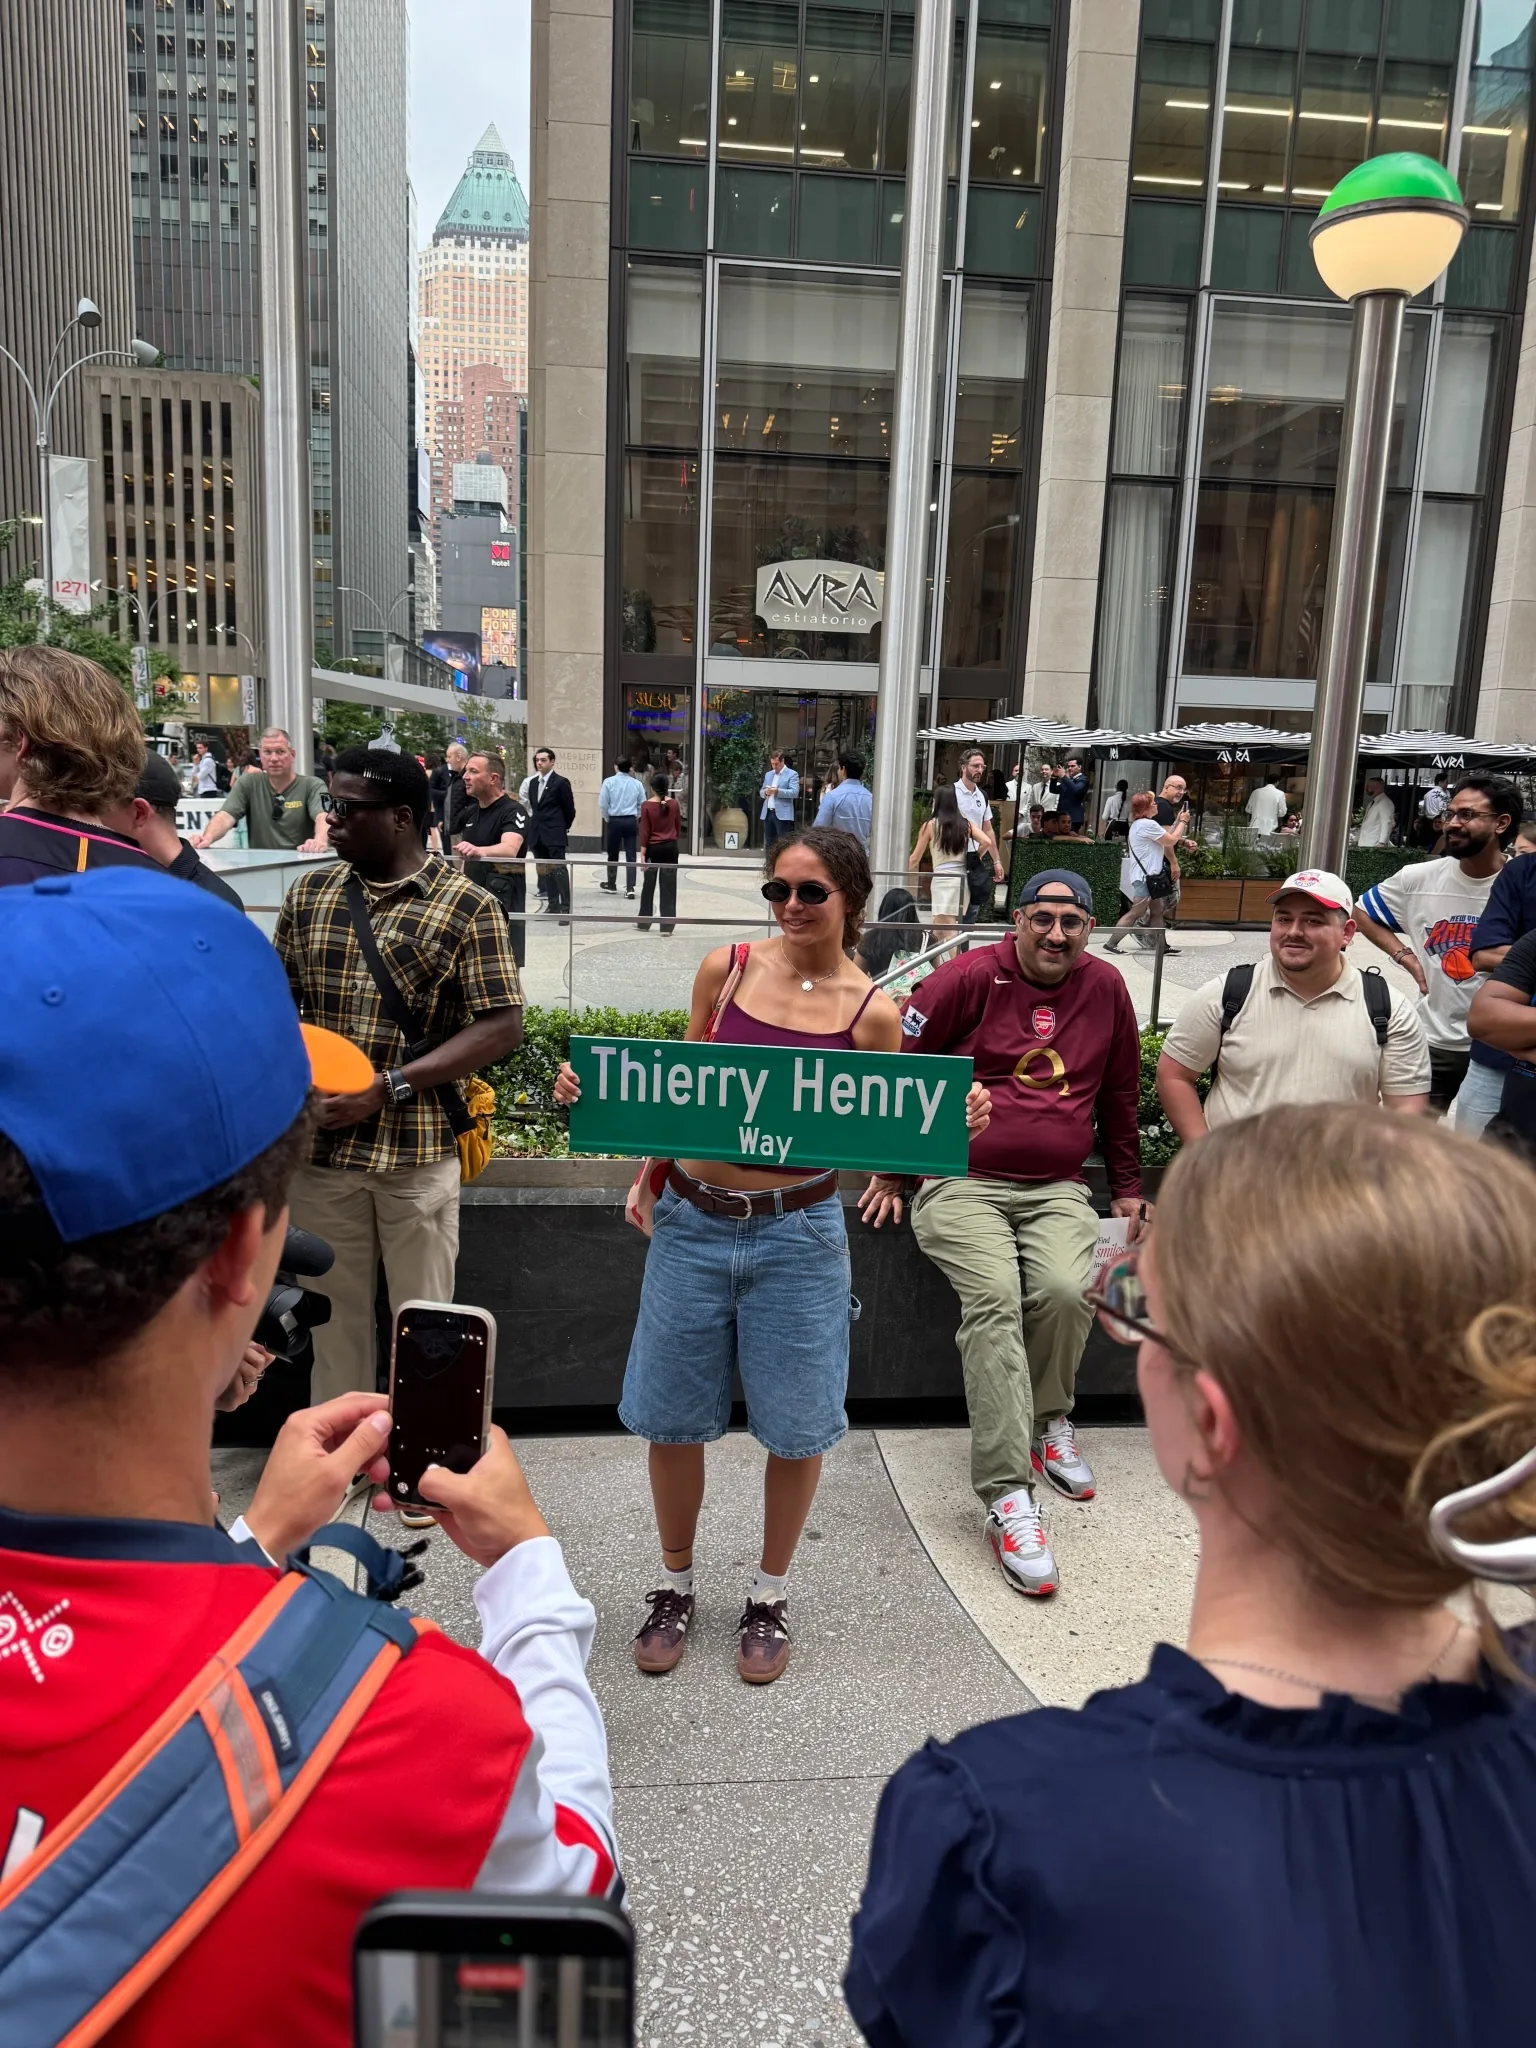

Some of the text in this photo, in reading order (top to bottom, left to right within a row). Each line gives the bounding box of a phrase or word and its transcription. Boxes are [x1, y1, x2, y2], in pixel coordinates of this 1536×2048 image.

[56, 580, 88, 596] 1271
[763, 568, 878, 613] AVRA
[771, 612, 868, 627] estiatorio
[556, 762, 597, 771] UILDING
[1432, 753, 1465, 769] AVRA
[727, 834, 737, 845] A
[1450, 914, 1467, 923] NEW
[1424, 919, 1478, 950] KNIC
[590, 1045, 947, 1135] Thierry Henry
[738, 1126, 793, 1164] Way
[1095, 1243, 1125, 1258] smiles
